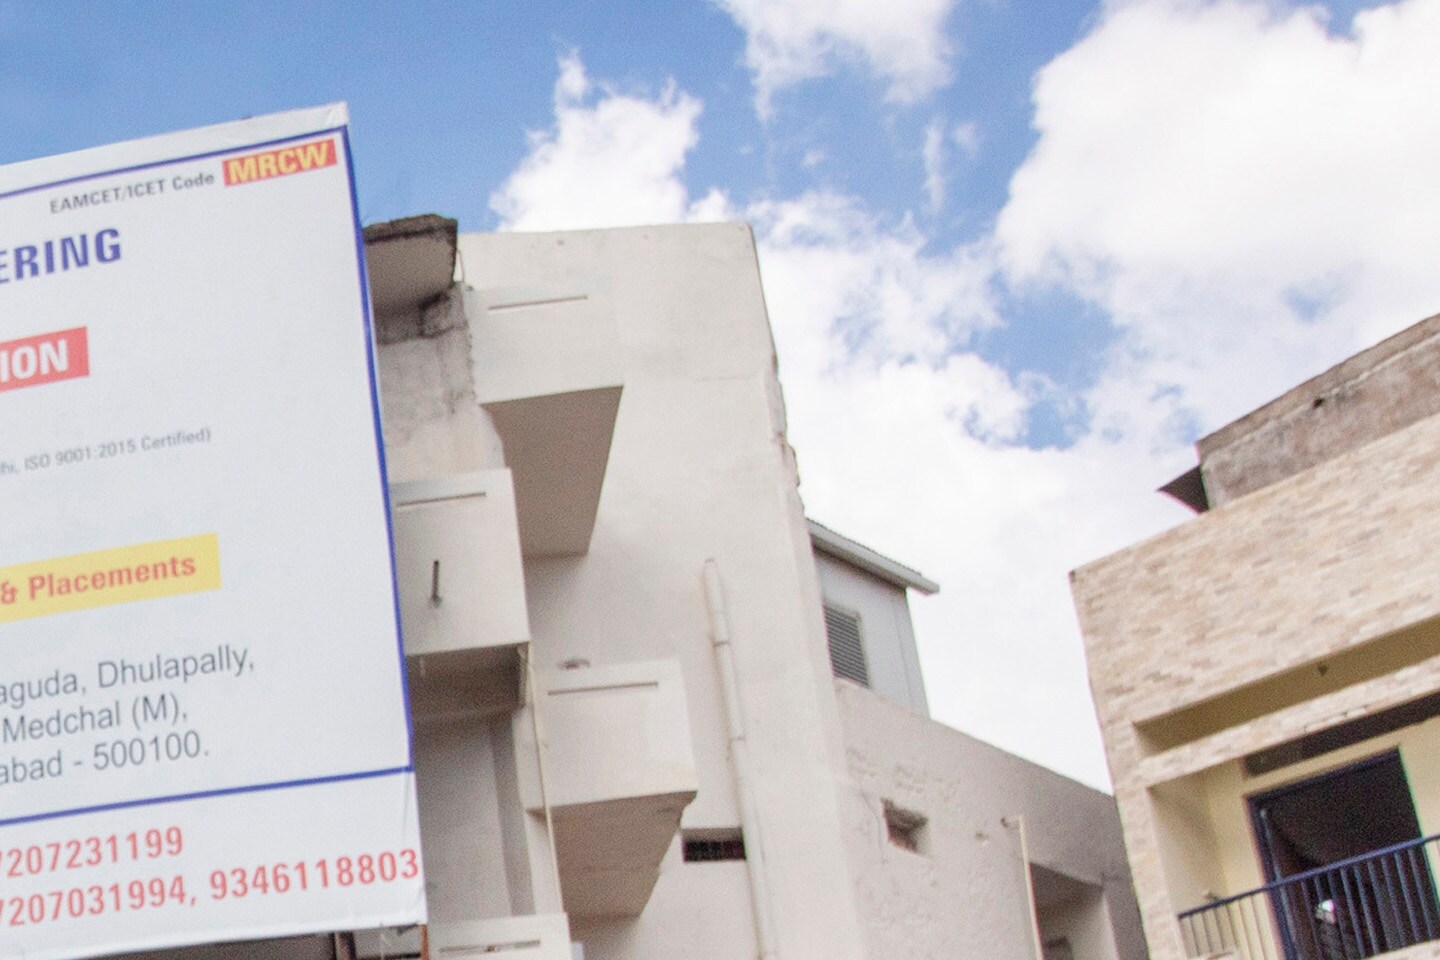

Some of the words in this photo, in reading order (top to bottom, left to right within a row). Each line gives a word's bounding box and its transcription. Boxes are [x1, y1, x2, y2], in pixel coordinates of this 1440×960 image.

[50, 180, 166, 214] EAMCET/ICET
[173, 172, 215, 192] Code
[229, 141, 330, 184] MRCW
[24, 454, 50, 471] ISO
[141, 427, 211, 451] Certified)
[0, 581, 18, 605] &
[29, 556, 196, 600] Placements
[98, 644, 254, 690] Dhulapally,
[2, 701, 121, 744] Medchal
[132, 692, 188, 731] (M),
[93, 729, 209, 771] 500100.
[209, 848, 418, 901] 9346118803
